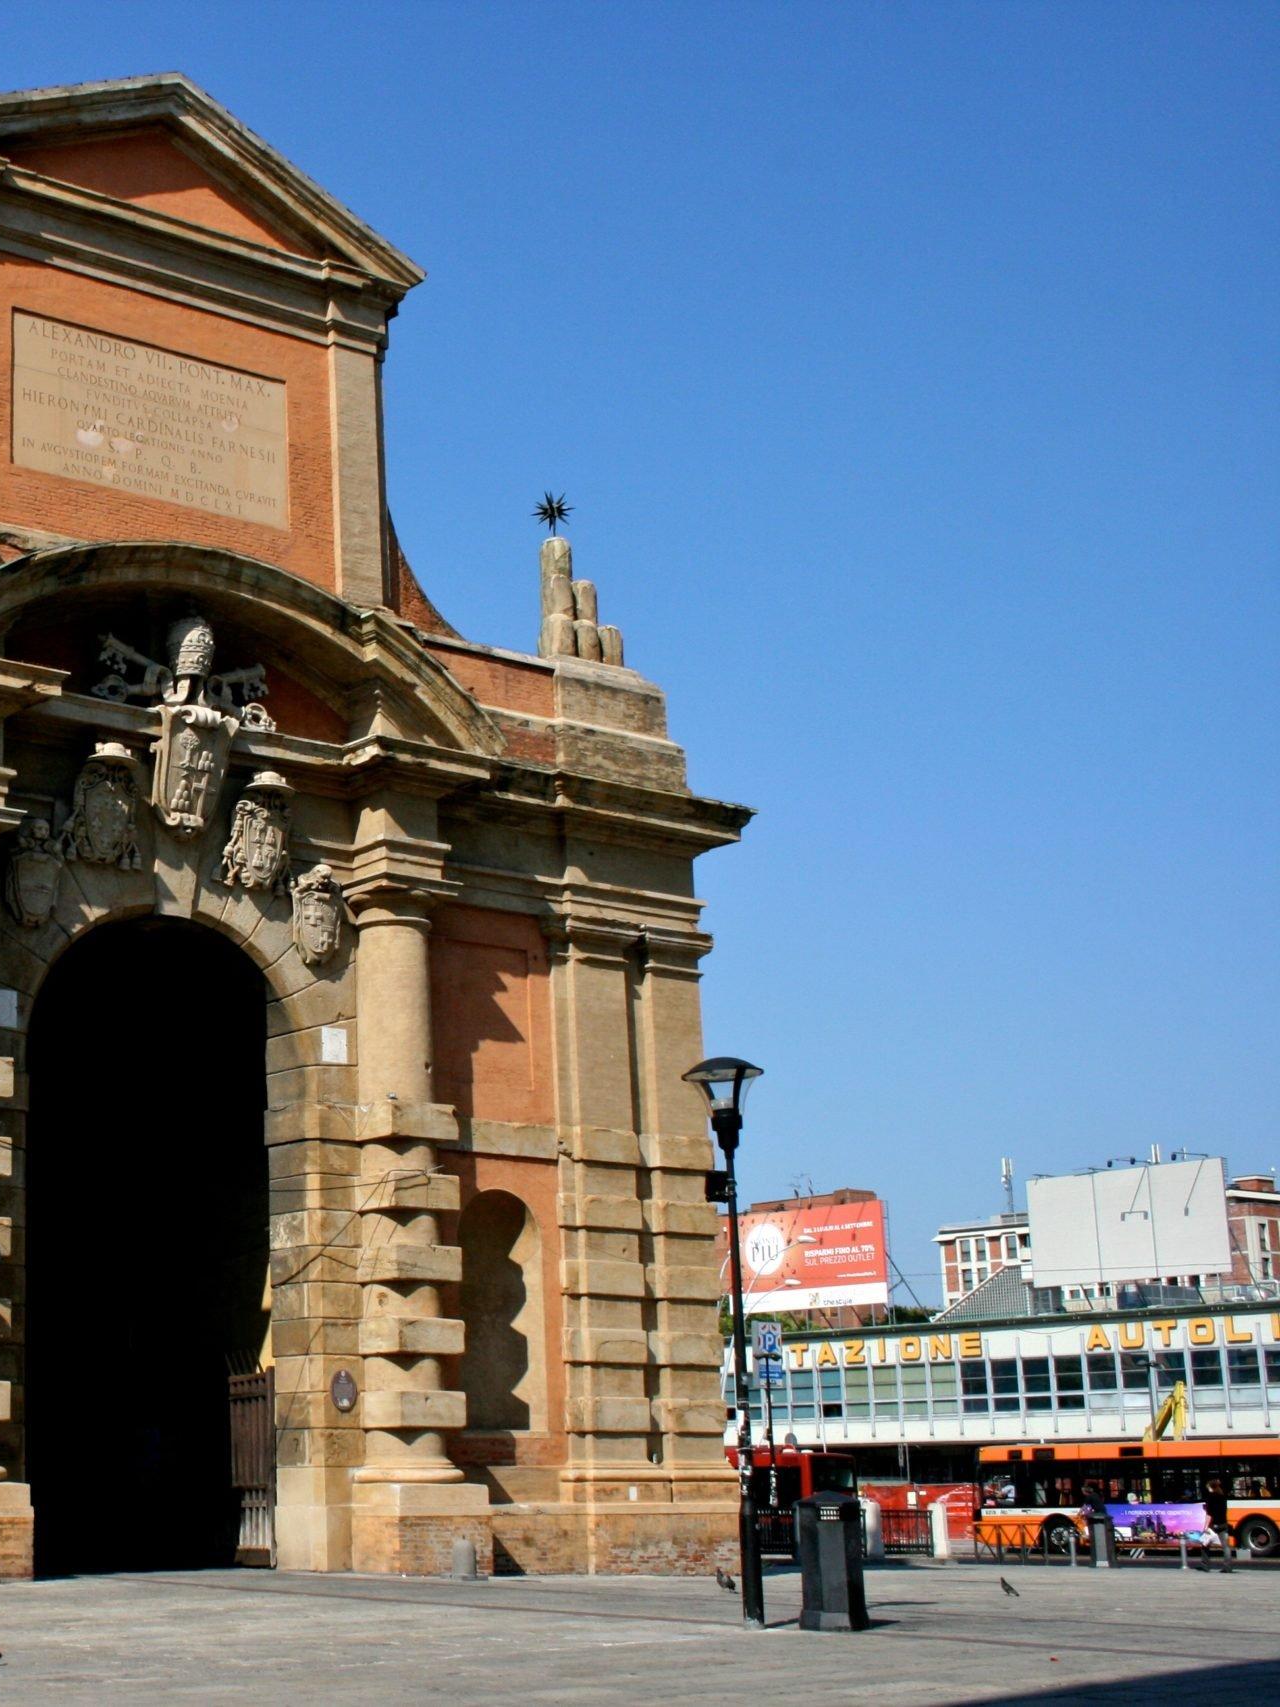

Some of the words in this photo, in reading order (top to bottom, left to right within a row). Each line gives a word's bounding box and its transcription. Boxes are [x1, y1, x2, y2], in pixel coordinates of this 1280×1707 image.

[29, 321, 137, 361] ALEXANDRO
[145, 351, 173, 371] VII.
[179, 361, 225, 385] PONT.
[230, 374, 271, 398] MAX.
[51, 348, 106, 372] PORTAM
[115, 365, 130, 378] ET
[137, 373, 191, 395] ADIECTA
[200, 389, 248, 411] MOENIA
[57, 366, 137, 395] CLANDESTINO
[143, 389, 191, 410] AQVARVM
[22, 387, 108, 421] HIERONYMI
[116, 412, 204, 446] CARDINALIS
[212, 436, 276, 464] FARNESII
[153, 406, 213, 430] COLLAPSA
[76, 420, 120, 437] QVARTO
[191, 448, 223, 463] ANNO
[22, 437, 35, 448] IN
[122, 460, 169, 481] FORMAM
[175, 474, 231, 497] EXCITANDA
[62, 463, 103, 480] ANNO
[112, 474, 162, 495] DOMINI
[820, 1255, 846, 1264] PREZZO
[848, 1252, 875, 1262] OUTLET
[766, 1333, 774, 1350] P
[789, 1332, 982, 1366] TAZIONE
